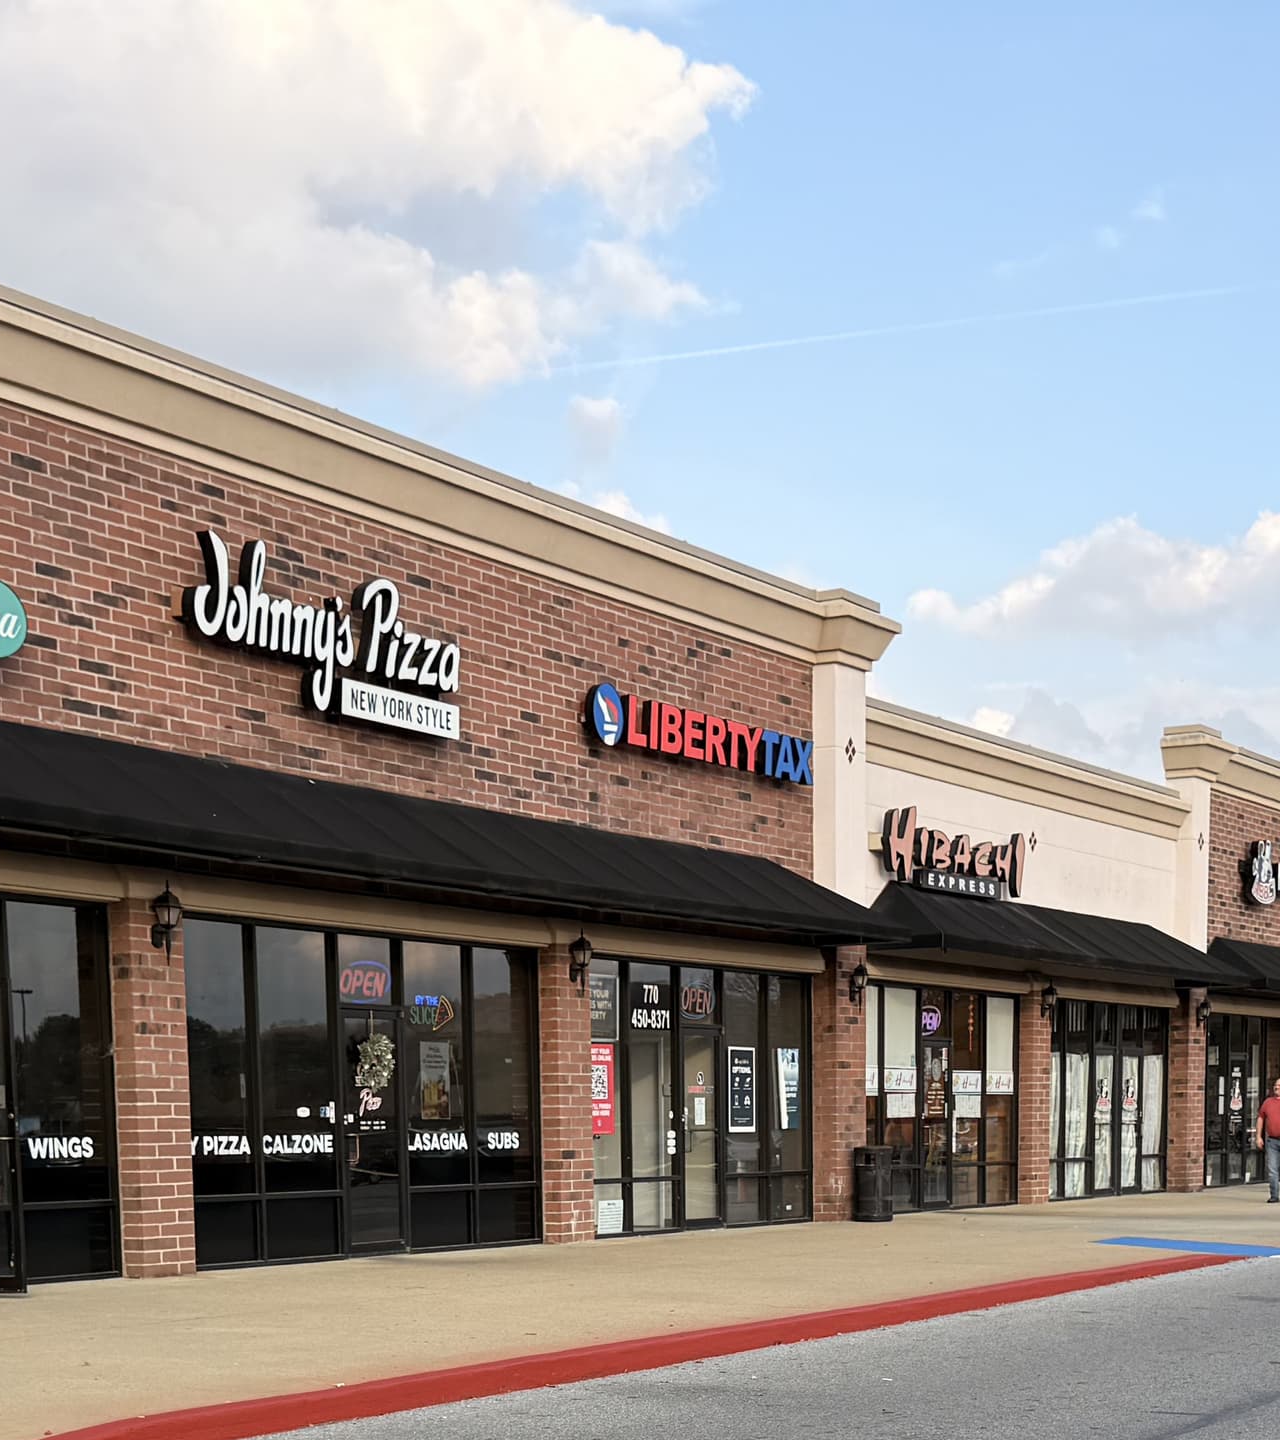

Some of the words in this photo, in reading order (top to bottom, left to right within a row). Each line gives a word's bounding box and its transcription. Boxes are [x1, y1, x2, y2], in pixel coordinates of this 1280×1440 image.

[193, 529, 354, 711] Johnny's
[362, 578, 461, 692] Pizza
[350, 687, 378, 714] NEW
[381, 698, 413, 723] YORK
[416, 705, 452, 731] STYLE
[887, 806, 1026, 897] HIBACHI
[928, 873, 995, 896] EXPRESS
[340, 969, 386, 997] OPEN
[643, 984, 659, 1004] 770
[415, 995, 424, 1006] BY
[425, 995, 439, 1007] THE
[681, 986, 711, 1014] OPEN
[410, 1006, 437, 1024] SLICE
[631, 1009, 670, 1029] 450-8371
[921, 1012, 939, 1031] PEN
[28, 1136, 94, 1159] WINGS
[203, 1135, 251, 1155] PIZZA
[263, 1134, 334, 1154] CALZONE
[407, 1132, 468, 1151] LASAGNA
[487, 1132, 519, 1149] SUBS
